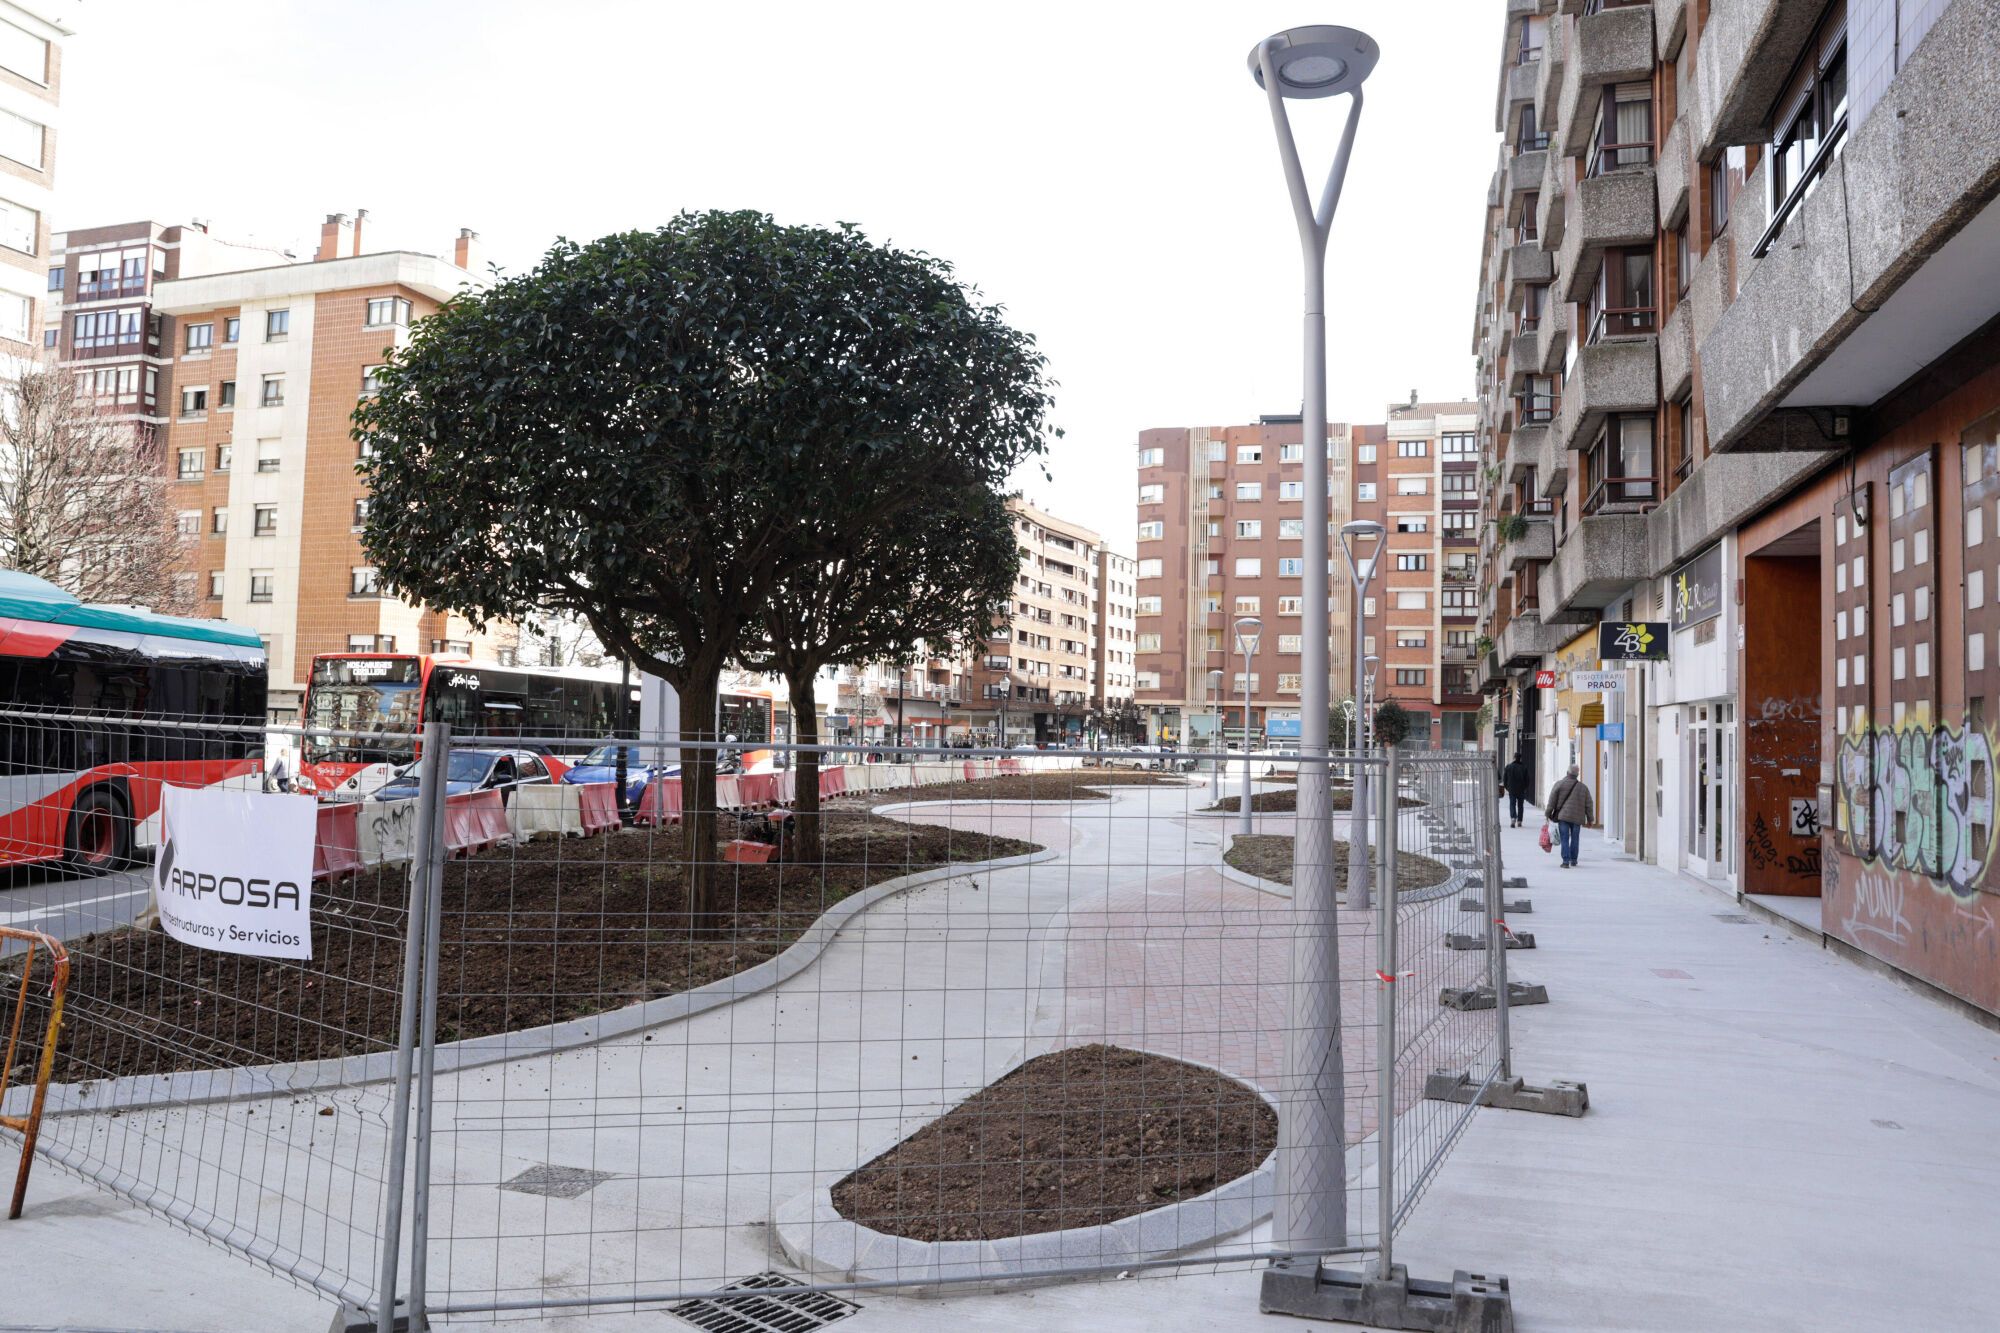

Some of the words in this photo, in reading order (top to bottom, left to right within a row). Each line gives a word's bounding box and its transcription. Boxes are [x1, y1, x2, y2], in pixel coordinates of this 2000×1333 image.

[1613, 626, 1641, 653] ZB
[326, 661, 332, 676] 1
[1537, 673, 1553, 687] illy
[1587, 681, 1617, 689] PRADO
[172, 867, 300, 911] ARPOSA
[217, 927, 226, 942] y
[228, 924, 301, 946] Servicios
